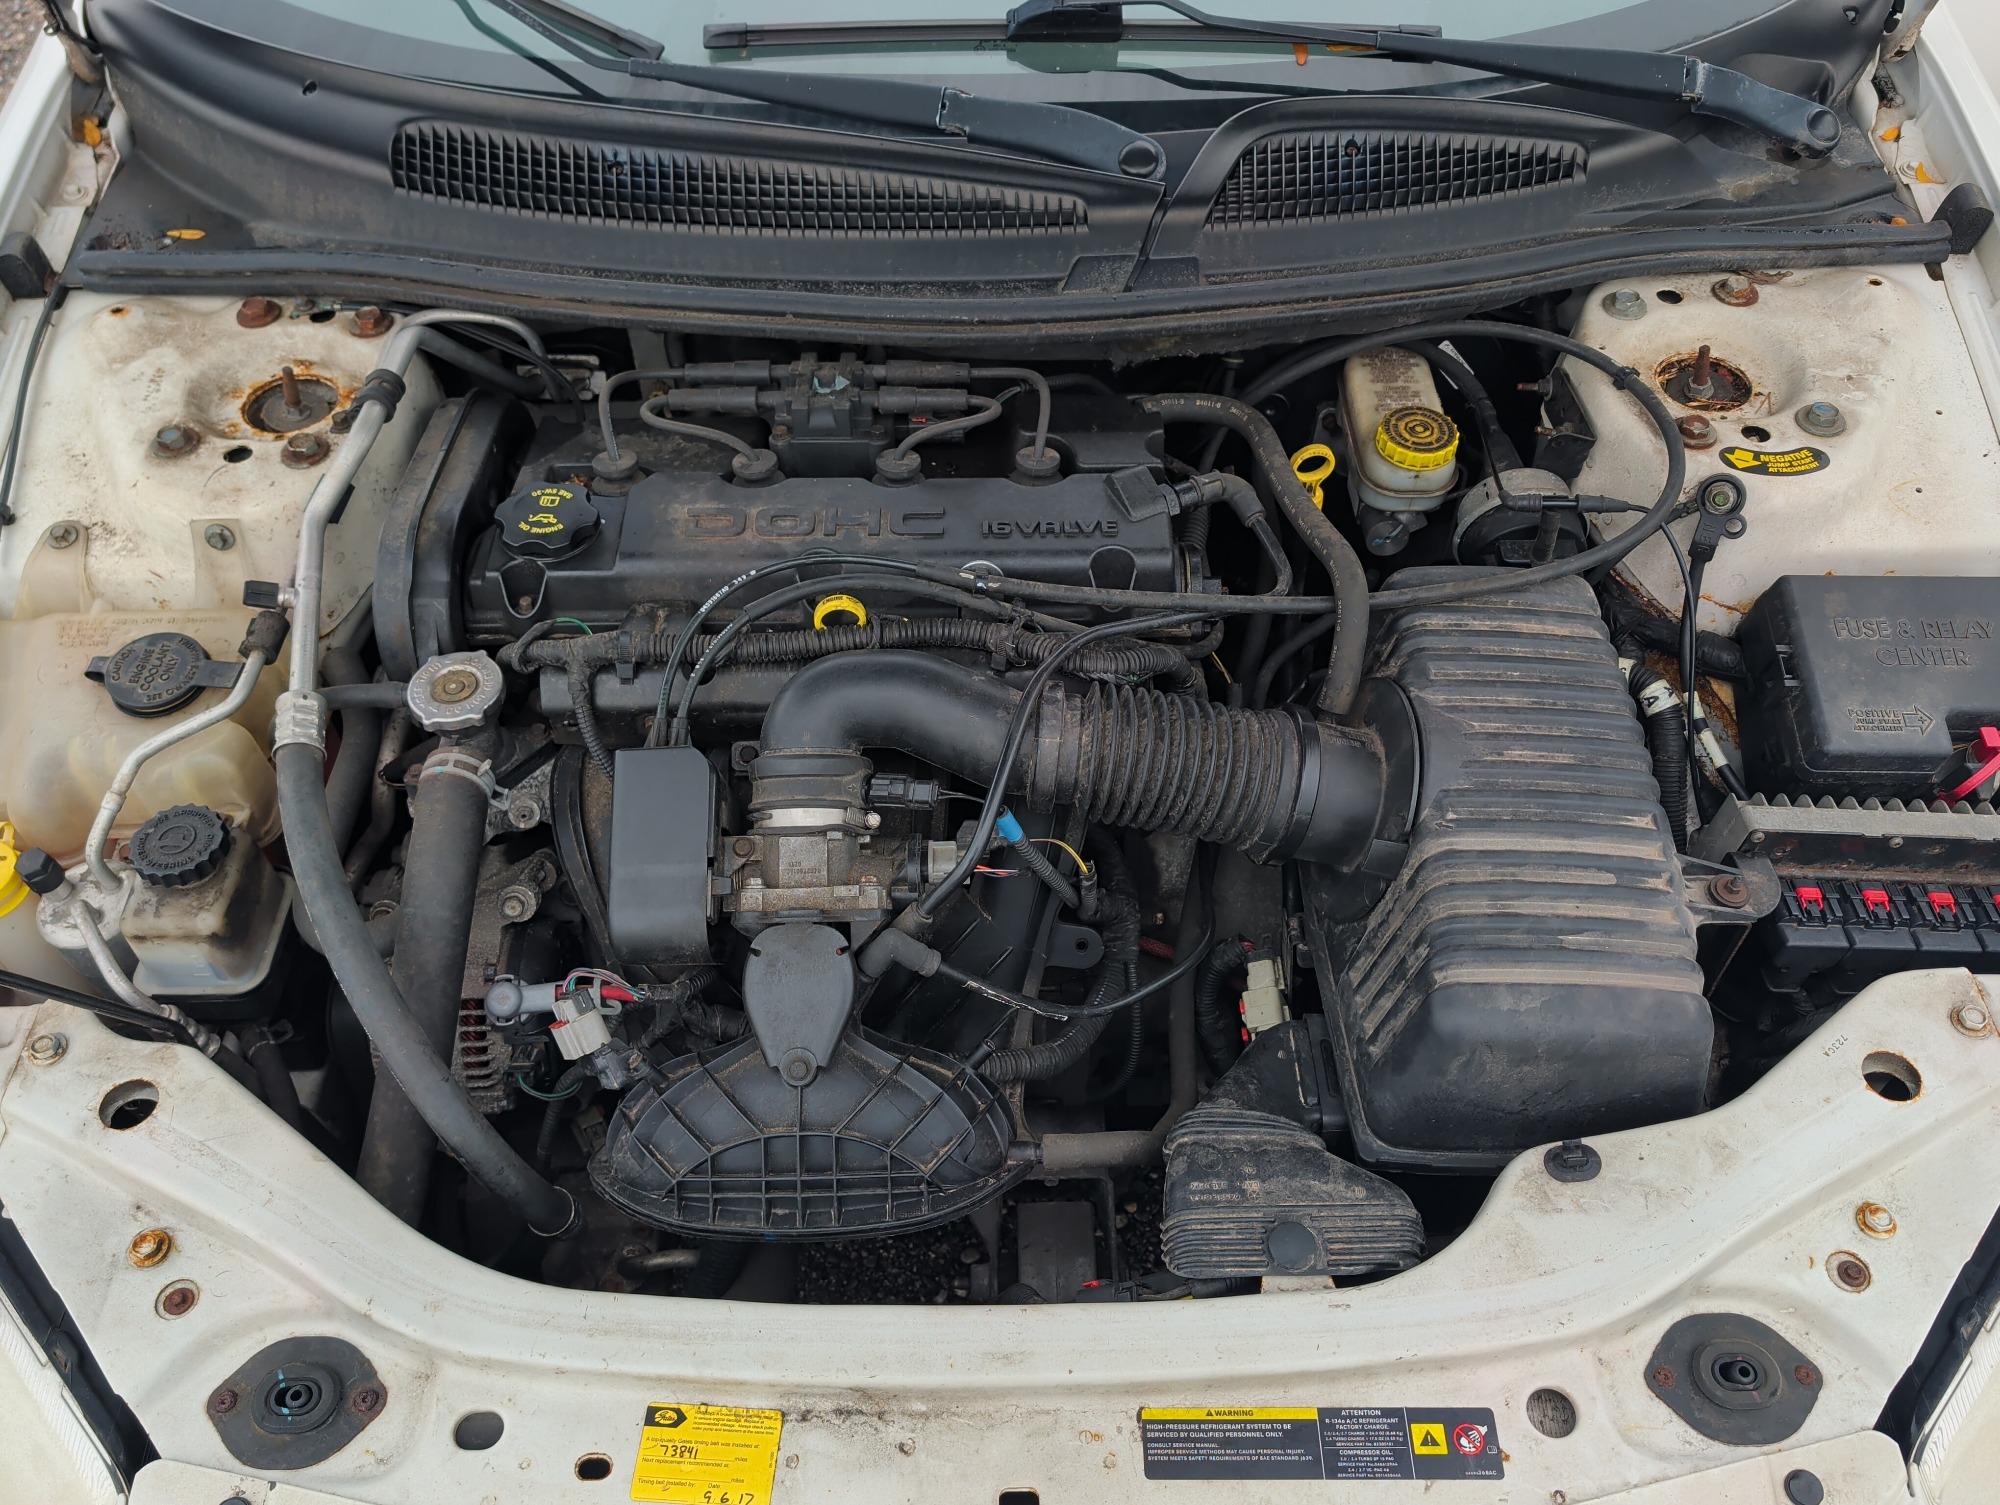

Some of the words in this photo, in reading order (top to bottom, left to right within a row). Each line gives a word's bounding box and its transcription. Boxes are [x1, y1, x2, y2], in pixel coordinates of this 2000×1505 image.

[1760, 450, 1813, 462] NEGATIVE
[1793, 458, 1814, 466] START
[1768, 462, 1819, 472] ATTACHMENT
[531, 488, 558, 497] 5W-30
[558, 490, 573, 499] SAE
[518, 522, 530, 531] OIL
[686, 506, 946, 539] DOHC
[530, 524, 564, 534] ENGINE
[1833, 618, 1892, 639] FUSE
[1897, 619, 1914, 639] &
[1920, 619, 1994, 639] RELAY
[1876, 647, 1970, 666] CENTER
[112, 646, 136, 682] CAUTION
[129, 648, 156, 684] ENGINE
[140, 643, 171, 692] COOLANT
[160, 656, 179, 682] ONLY
[145, 690, 162, 702] SEE
[1848, 708, 1900, 718] POSITIVE
[655, 1411, 676, 1422] Gates
[660, 1445, 698, 1459] 73841
[720, 1492, 729, 1504] 6
[739, 1493, 754, 1505] 17
